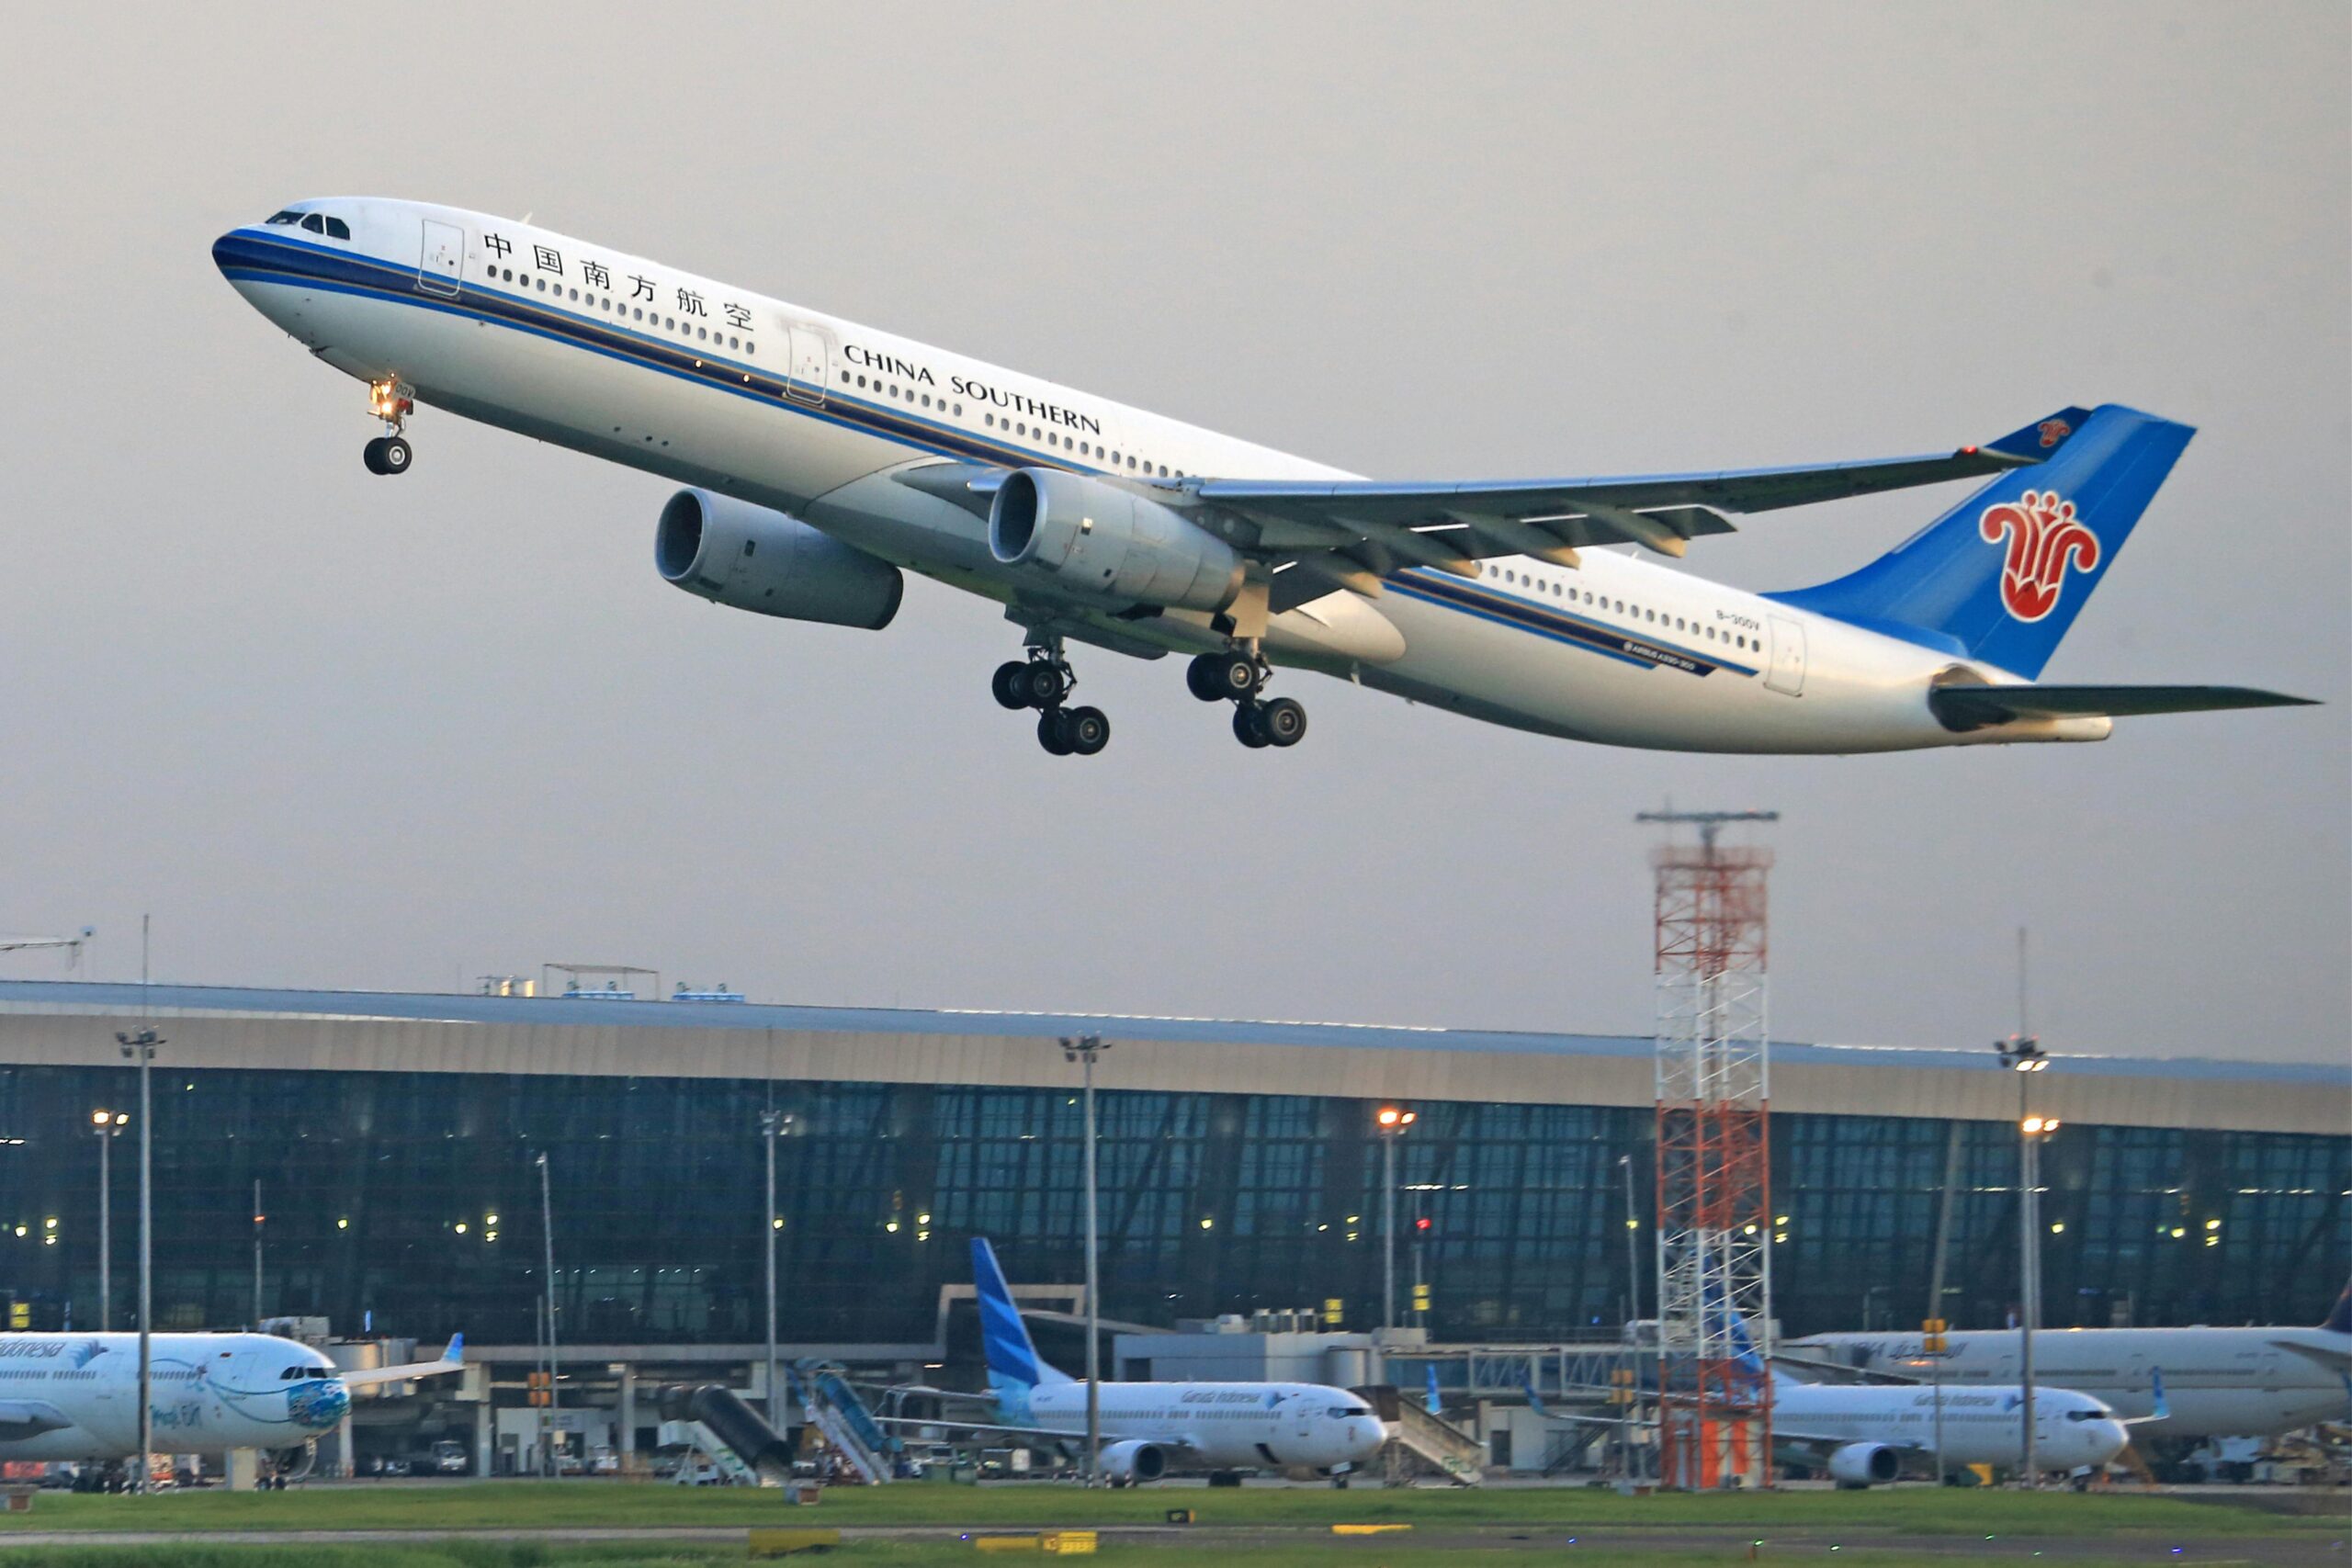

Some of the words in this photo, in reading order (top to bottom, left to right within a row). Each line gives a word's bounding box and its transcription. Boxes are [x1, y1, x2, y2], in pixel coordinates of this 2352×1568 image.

[484, 232, 754, 333] 中国南方航空
[843, 344, 935, 387] CHINA
[951, 376, 1102, 435] SOUTHERN
[0, 1338, 67, 1358] donesia
